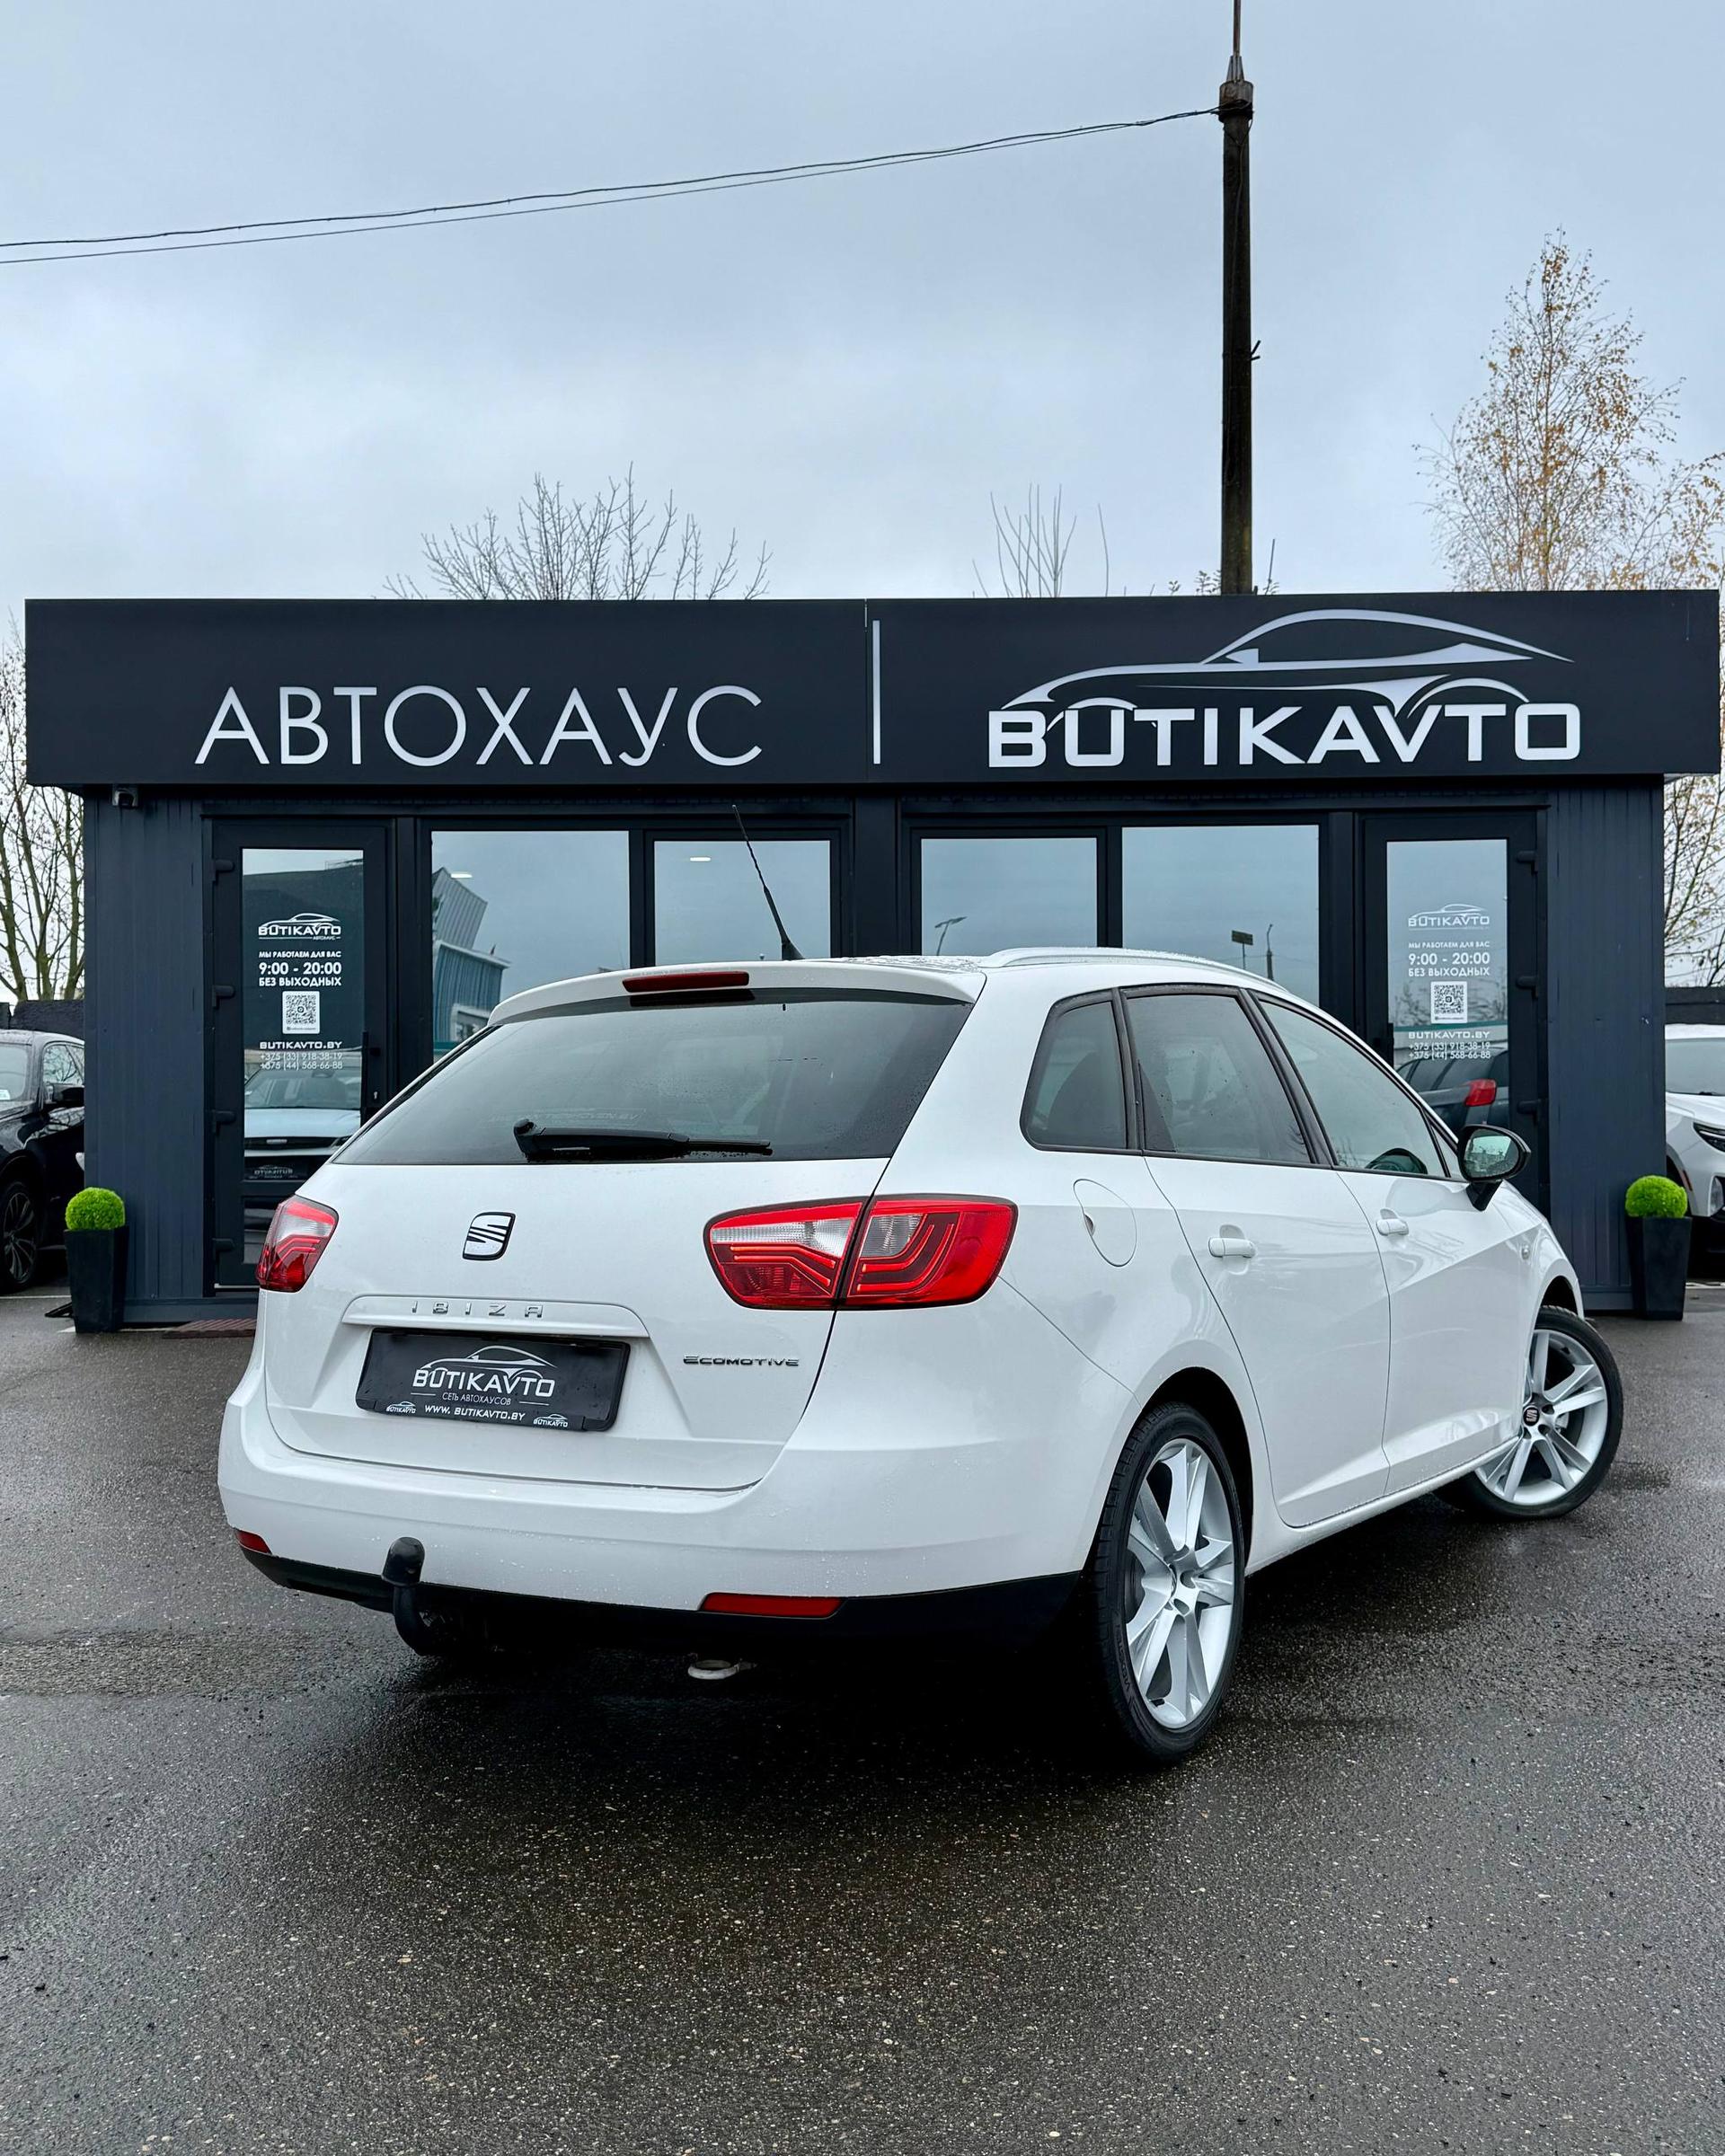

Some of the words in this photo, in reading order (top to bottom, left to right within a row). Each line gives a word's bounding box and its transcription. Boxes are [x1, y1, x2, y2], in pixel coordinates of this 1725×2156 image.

[195, 685, 763, 767] АВТОХАУС
[988, 702, 1580, 769] BUTIKAVTO
[1408, 915, 1491, 927] BUTIKAVTO
[258, 925, 341, 936] BUTIKAVTO
[1459, 941, 1473, 949] ДЛЯ
[259, 950, 271, 959] МЫ
[272, 950, 309, 959] РАБОТАЕМ
[310, 950, 325, 959] ДЛЯ
[326, 950, 341, 959] ВАС
[1408, 952, 1438, 966] 9:00
[1452, 951, 1491, 965] 20:00
[258, 961, 289, 976] 9:00
[303, 961, 342, 976] 20:00
[1408, 968, 1426, 977] БЕЗ
[1428, 967, 1491, 977] ВЫХОДНЫХ
[259, 976, 277, 986] БЕЗ
[279, 976, 341, 987] ВЫХОДНЫХ
[1408, 1030, 1491, 1039] BUTIKAVTO.BY
[260, 1041, 342, 1049] BUTIKAVTO.BY
[411, 1300, 544, 1319] IBIZA
[683, 1355, 800, 1367] ECOMOTIVE
[411, 1368, 555, 1398] BUTIKAVTO
[442, 1392, 459, 1401] СЕТЬ
[460, 1393, 511, 1406] АВТОХАУСОВ
